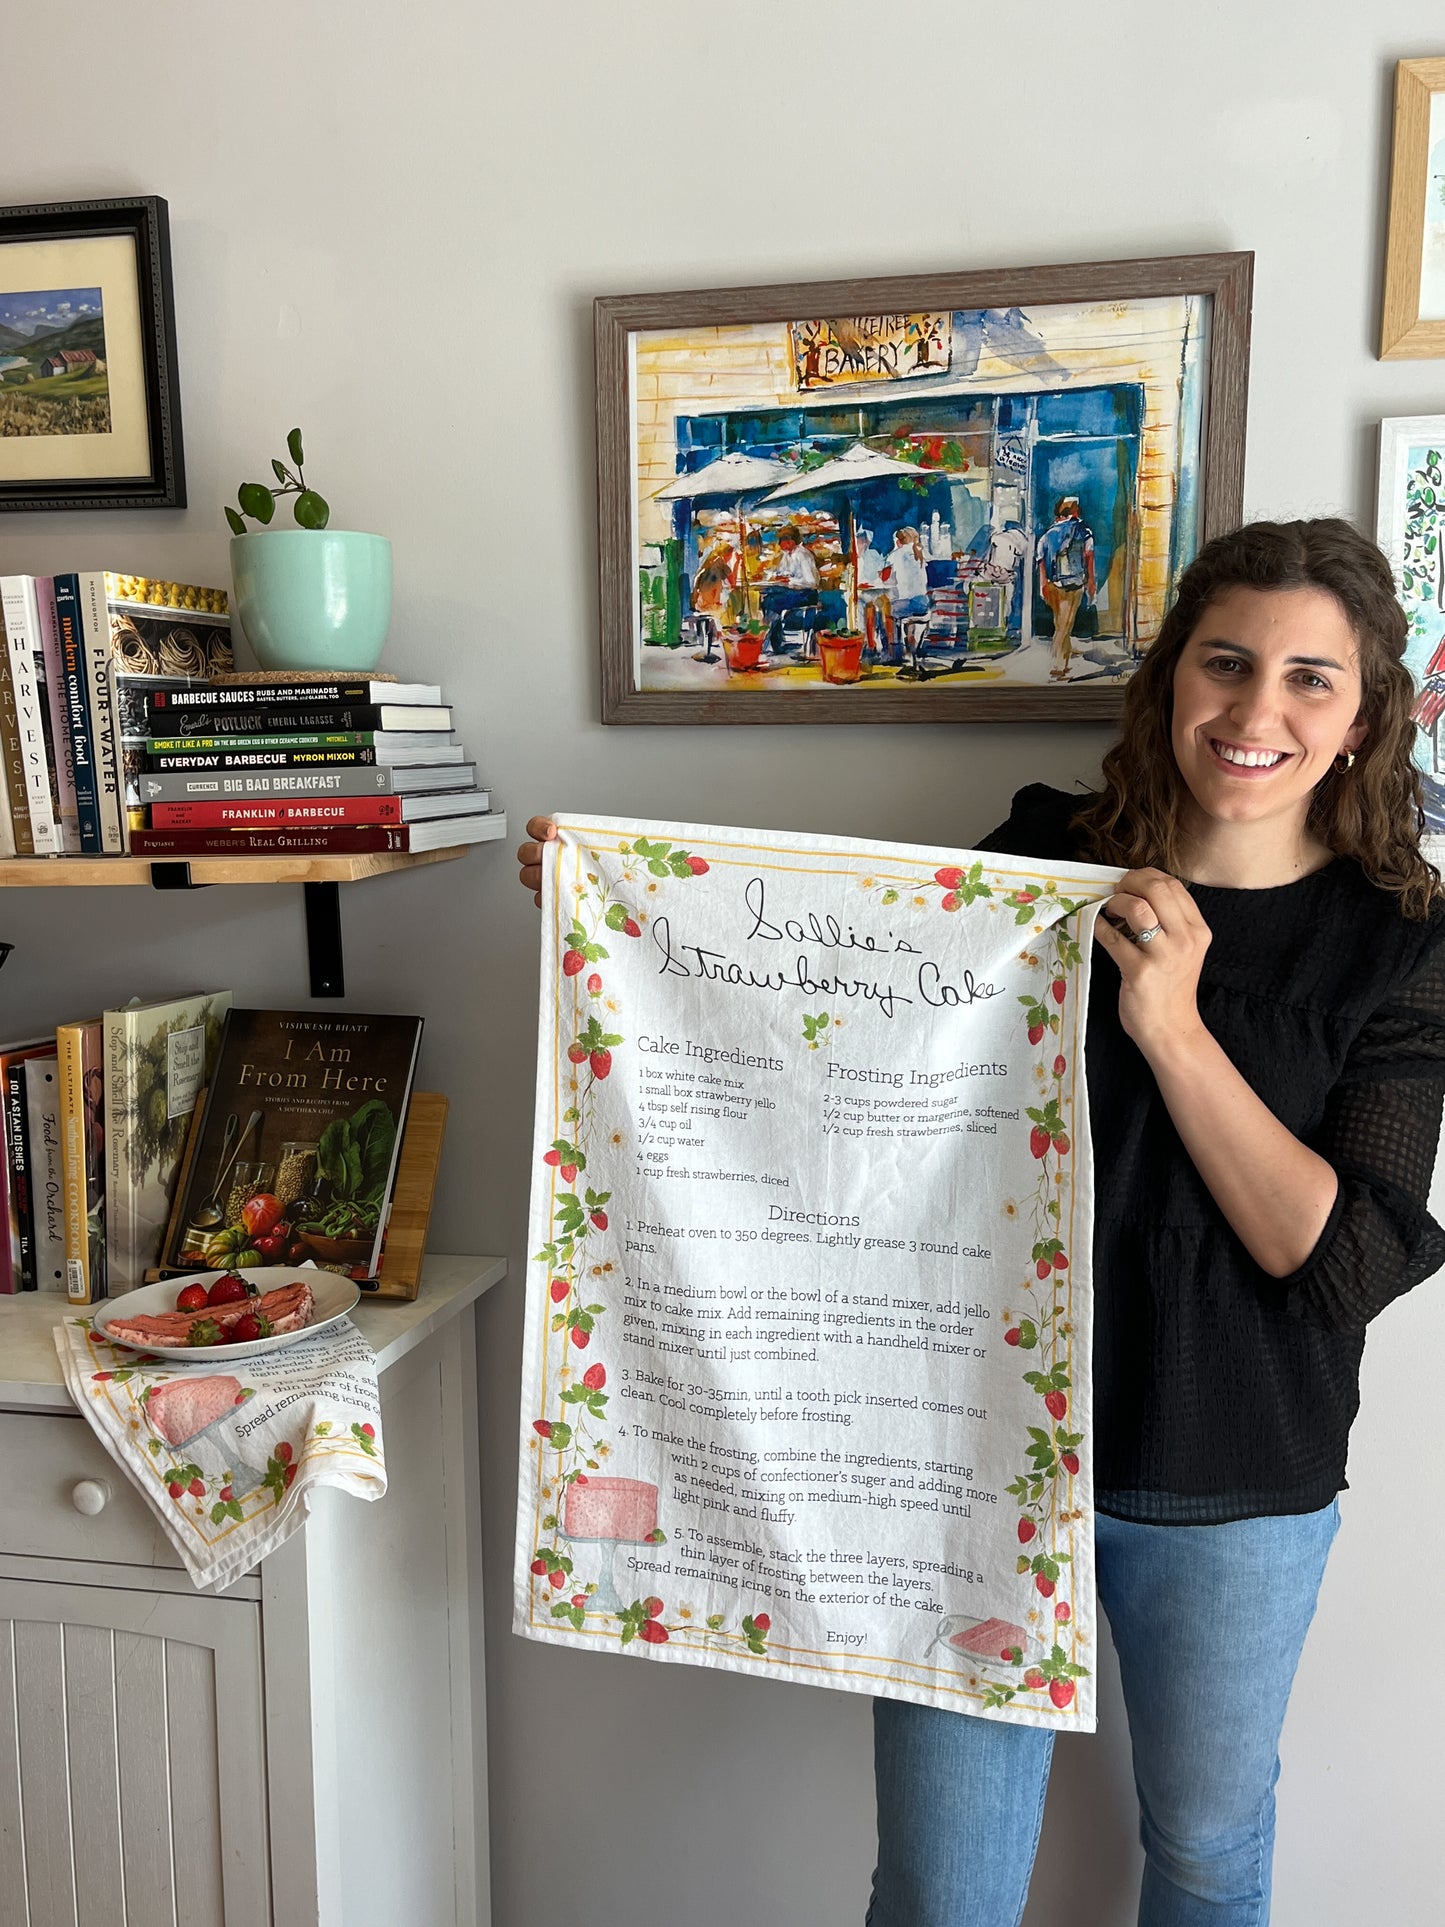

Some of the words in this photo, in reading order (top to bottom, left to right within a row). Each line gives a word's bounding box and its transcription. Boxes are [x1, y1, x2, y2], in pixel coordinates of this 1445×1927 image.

[63, 618, 77, 672] modern
[56, 676, 66, 699] THE
[171, 692, 218, 705] BARBECUE
[219, 691, 255, 703] SAUCES
[14, 638, 42, 788] HARVEST
[68, 675, 84, 729] comfort
[58, 705, 70, 744] HOME
[93, 649, 109, 710] FLOUR
[101, 728, 115, 793] WATER
[214, 716, 263, 731] POTLUCK
[268, 717, 297, 727] EMERIL
[300, 715, 334, 725] LAGASSE
[74, 736, 89, 766] food
[154, 741, 174, 749] SMOKE
[182, 740, 196, 748] LIKE
[201, 739, 213, 747] PRO
[64, 750, 76, 788] COOK
[160, 756, 219, 767] EVERYDAY
[225, 754, 287, 765] BARBECUE
[326, 753, 355, 761] MIXON
[224, 779, 243, 792] BIG
[246, 779, 269, 791] BAD
[274, 776, 341, 790] BREAKFAST
[222, 809, 275, 819] FRANKLIN
[288, 808, 345, 816] BARBECUE
[206, 839, 246, 847] WEBER'S
[249, 836, 275, 847] REAL
[278, 836, 328, 846] GRILLING
[745, 877, 922, 955] Sallie's
[652, 916, 913, 1018] Strawberry
[918, 961, 1006, 1007] Cake
[279, 1022, 331, 1031] VISHWESH
[336, 1024, 369, 1032] BHATT
[284, 1039, 294, 1060] I
[304, 1040, 351, 1063] Am
[638, 1036, 679, 1054] Cake
[685, 1041, 783, 1071] Ingredients
[10, 1080, 19, 1094] 101
[237, 1064, 307, 1088] From
[321, 1068, 387, 1092] Here
[640, 1069, 643, 1077] 1
[646, 1067, 663, 1079] box
[665, 1069, 695, 1082] white
[698, 1072, 721, 1085] cake
[724, 1079, 744, 1089] mix
[826, 1062, 904, 1088] Frosting
[909, 1062, 1007, 1088] Ingredients
[645, 1085, 671, 1096] small
[674, 1085, 693, 1097] box
[696, 1090, 752, 1108] strawberry
[754, 1098, 776, 1109] jello
[824, 1094, 841, 1105] 2-3
[844, 1097, 870, 1108] cups
[873, 1098, 928, 1109] powdered
[931, 1096, 958, 1108] sugar
[12, 1099, 21, 1132] ASIAN
[639, 1102, 644, 1111] 4
[648, 1100, 668, 1114] tbsp
[670, 1102, 688, 1113] self
[690, 1106, 720, 1118] rising
[723, 1106, 748, 1120] flour
[824, 1108, 840, 1121] 1/2
[843, 1113, 864, 1123] cup
[867, 1111, 900, 1122] butter
[975, 1106, 1019, 1120] softened
[42, 1113, 58, 1146] Food
[638, 1132, 654, 1145] 1/2
[657, 1136, 675, 1147] cup
[677, 1138, 705, 1146] water
[823, 1123, 839, 1135] 1/2
[843, 1128, 863, 1138] cup
[866, 1126, 894, 1136] fresh
[897, 1125, 963, 1136] strawberries,
[967, 1121, 997, 1134] sliced
[14, 1135, 24, 1171] DISHES
[637, 1167, 640, 1175] 1
[643, 1168, 663, 1179] cup
[666, 1166, 690, 1178] fresh
[693, 1169, 758, 1183] strawberries,
[761, 1173, 790, 1187] diced
[46, 1182, 63, 1242] Orchard
[768, 1205, 859, 1226] Directions
[626, 1221, 633, 1230] 1.
[637, 1221, 685, 1240] Preheat
[689, 1229, 717, 1239] oven
[720, 1229, 732, 1239] to
[735, 1230, 757, 1242] 350
[761, 1227, 812, 1244] degrees.
[816, 1232, 861, 1249] Lightly
[864, 1238, 905, 1250] grease
[909, 1241, 916, 1252] 3
[919, 1242, 958, 1255] round
[962, 1244, 991, 1259] cake
[273, 1384, 300, 1393] thin
[304, 1380, 336, 1389] layer
[235, 1405, 275, 1438] Spread
[276, 1390, 340, 1413] remaining
[342, 1395, 371, 1410] icing
[621, 1385, 655, 1402] clean.
[659, 1394, 686, 1410] Cool
[689, 1404, 757, 1424] completely
[760, 1407, 798, 1421] before
[802, 1407, 853, 1426] frosting.
[627, 1556, 671, 1576] Spread
[675, 1566, 738, 1588] remaining
[741, 1577, 772, 1596] icing
[774, 1589, 791, 1601] on
[795, 1589, 815, 1603] the
[819, 1592, 870, 1604] exterior
[873, 1592, 887, 1605] of
[889, 1593, 910, 1608] the
[915, 1598, 946, 1614] cake.
[826, 1631, 867, 1646] Enjoy!
